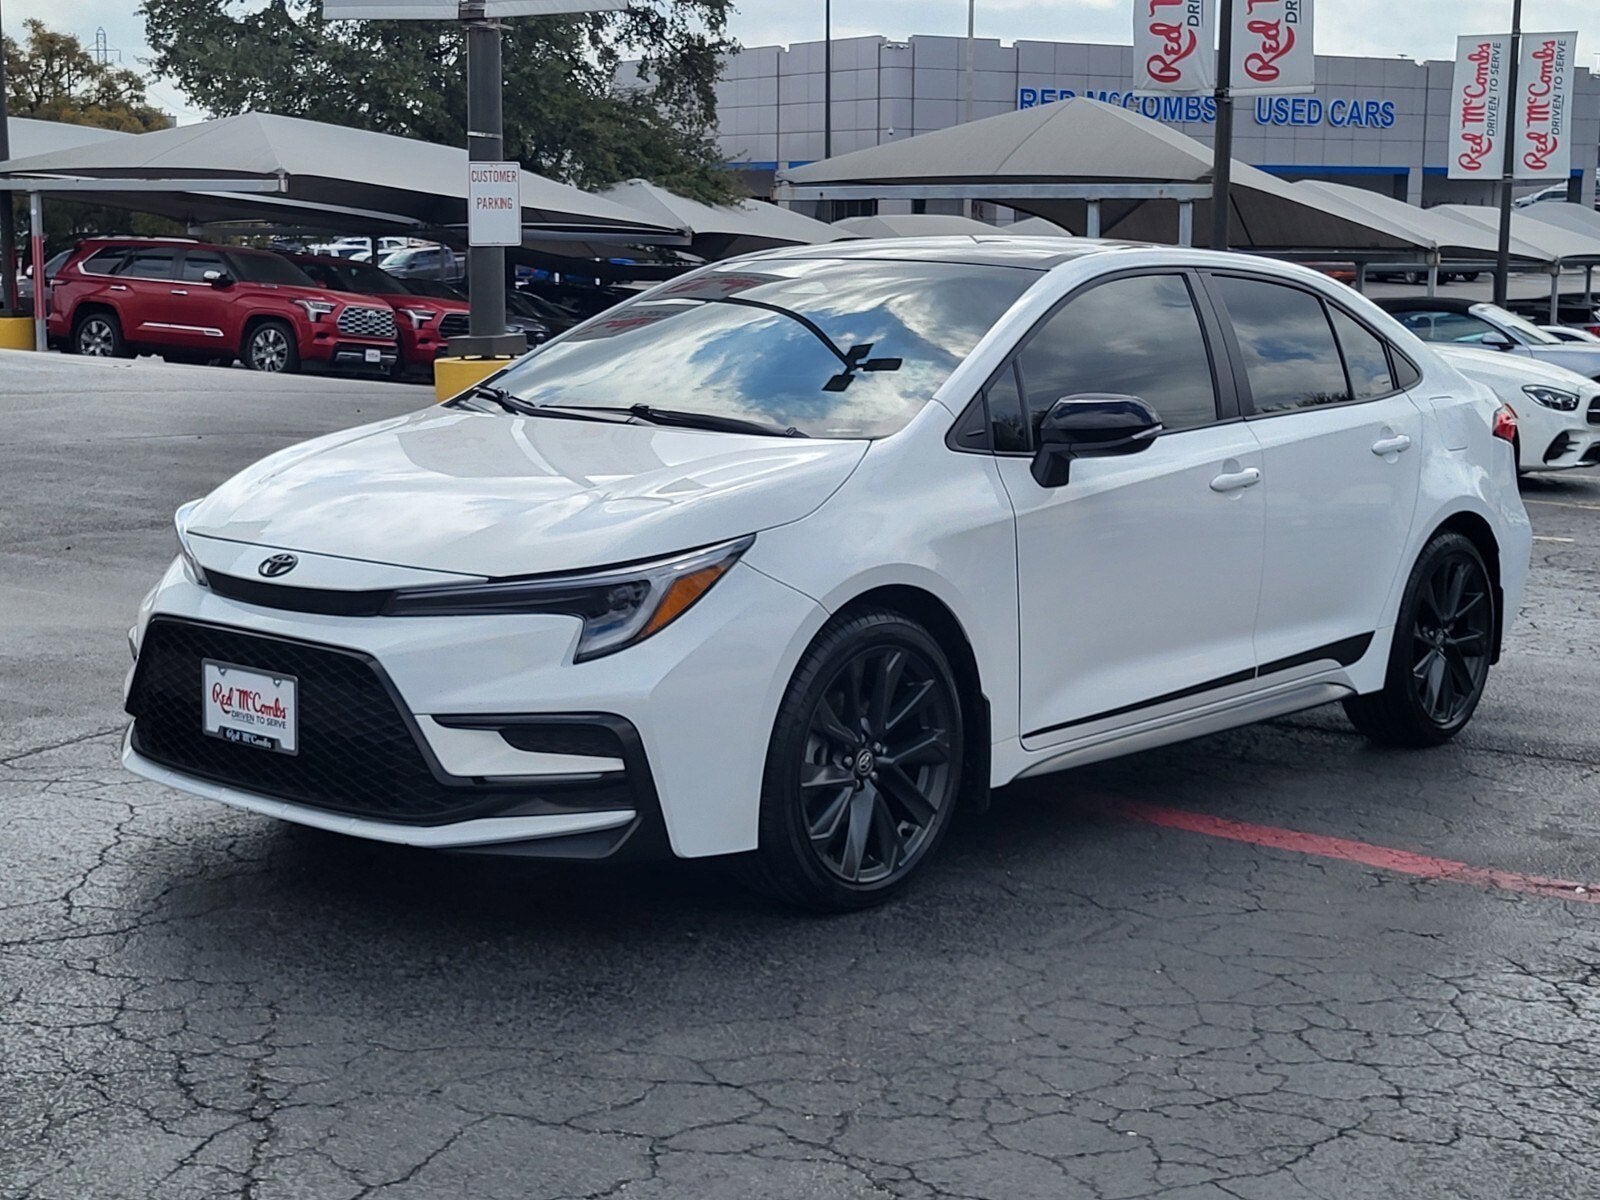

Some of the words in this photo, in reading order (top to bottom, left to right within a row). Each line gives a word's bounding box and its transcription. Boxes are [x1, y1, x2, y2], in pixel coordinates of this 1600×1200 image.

[1146, 22, 1197, 83] Red
[1244, 18, 1295, 82] Red
[1491, 42, 1501, 75] SERVE
[1555, 40, 1566, 73] SERVE
[1489, 78, 1498, 93] TO
[1553, 76, 1563, 91] TO
[1257, 97, 1322, 124] USED
[1330, 100, 1395, 126] CARS
[1487, 96, 1497, 137] DRIVEN
[1551, 94, 1561, 135] DRIVEN
[1458, 133, 1492, 171] Red
[1523, 132, 1558, 170] Red
[471, 170, 517, 182] CUSTOMER
[476, 198, 513, 210] PARKING
[212, 682, 234, 714] Red
[231, 710, 255, 722] DRIVEN
[256, 715, 265, 724] TO
[266, 717, 286, 729] SERVE
